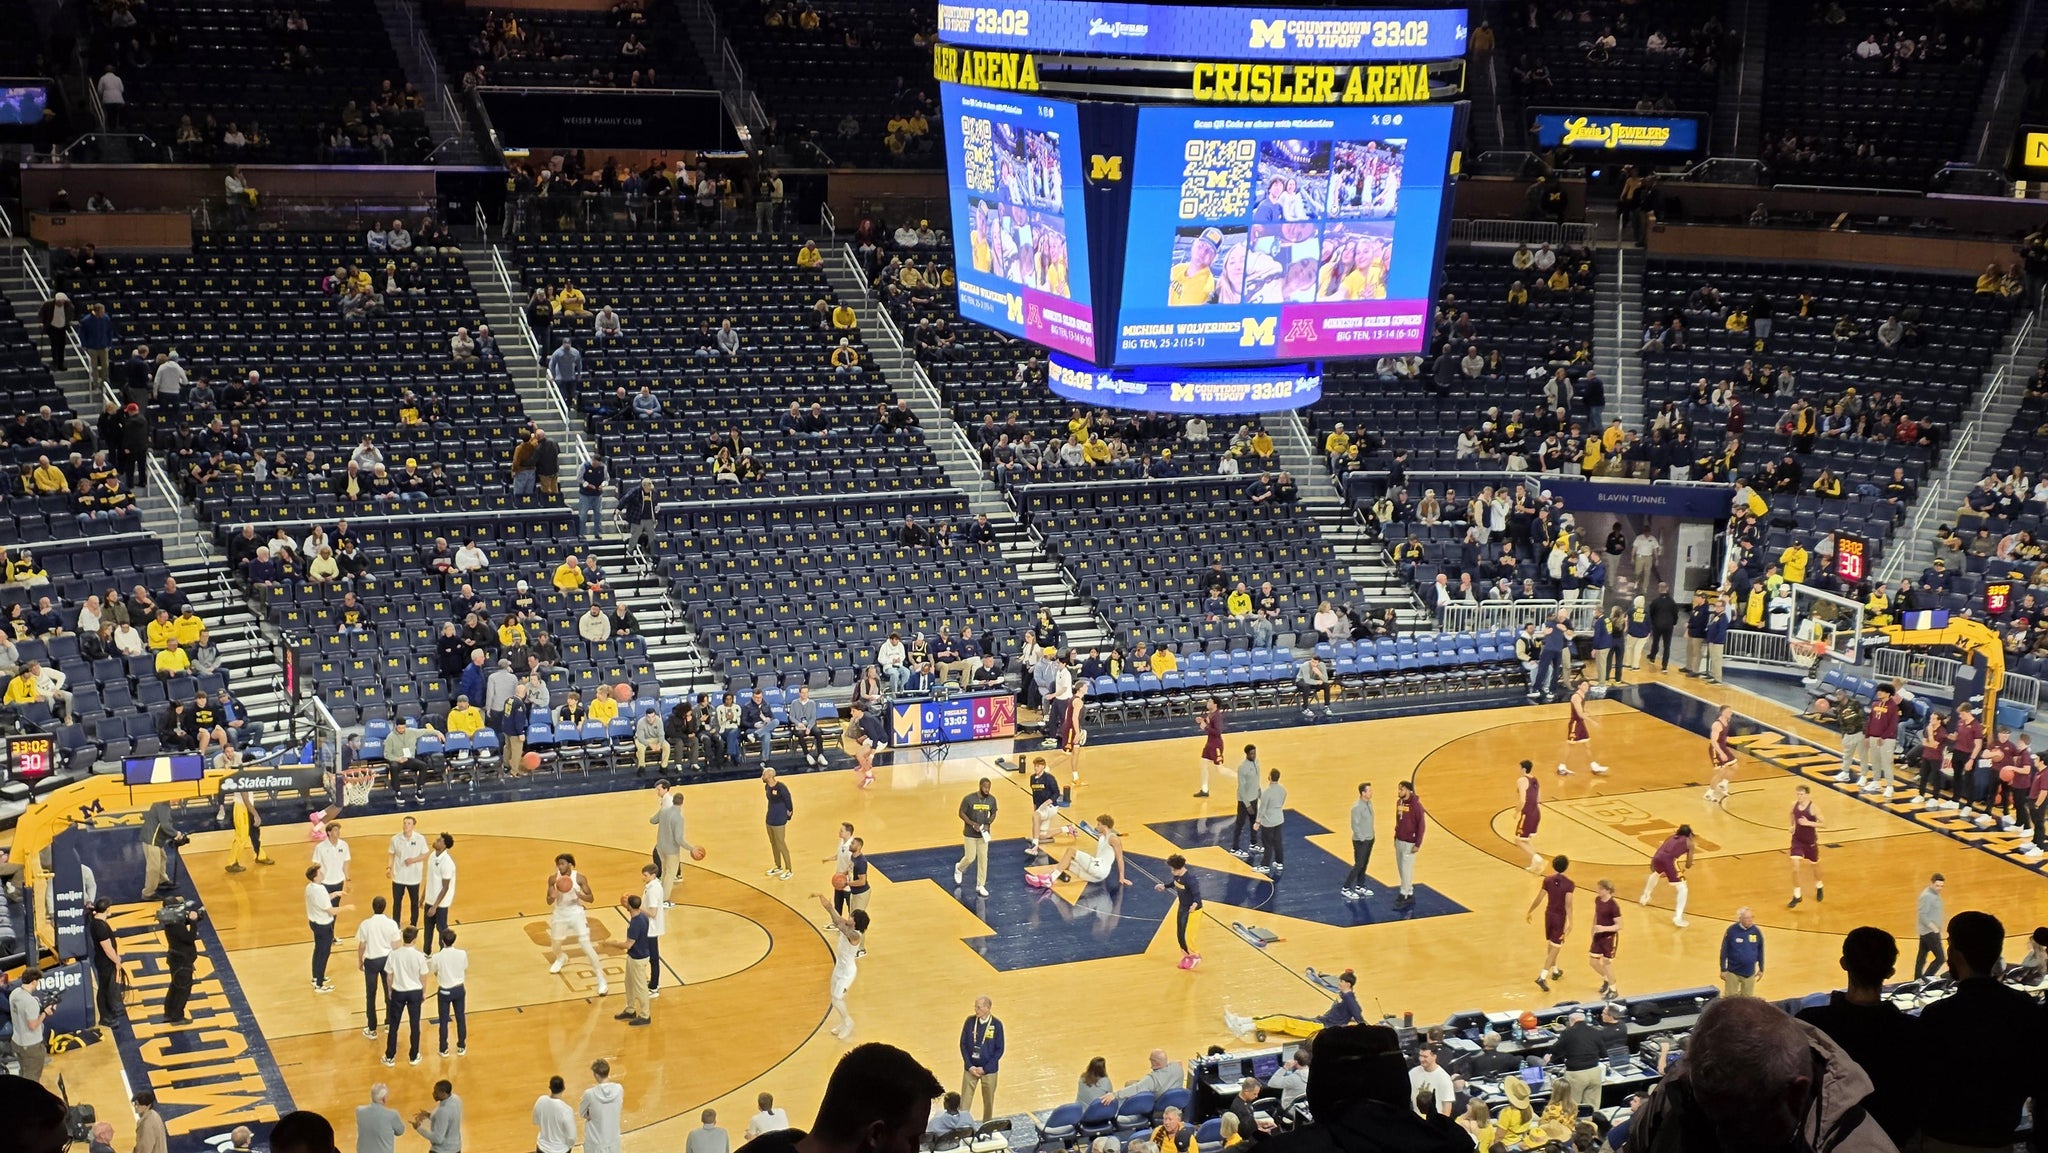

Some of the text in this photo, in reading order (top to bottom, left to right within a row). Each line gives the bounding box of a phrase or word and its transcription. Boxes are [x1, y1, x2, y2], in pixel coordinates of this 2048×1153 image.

[976, 8, 1029, 36] 33:02
[1287, 20, 1370, 35] COUNTDOWN
[1250, 19, 1286, 48] M
[1372, 21, 1428, 46] 33:02
[1296, 34, 1360, 48] TO TIPOFF
[961, 50, 1039, 90] ARENA
[1193, 63, 1430, 102] CRISLER ARENA
[563, 116, 642, 126] WEISER FAMILY CLUB
[1091, 155, 1122, 181] M
[1007, 292, 1024, 320] M
[1123, 322, 1241, 336] MICHIGAN WOLVERINES
[1239, 316, 1277, 347] M
[1336, 328, 1419, 342] BIG TEN, 13-14 (6-10)
[1122, 337, 1205, 350] BIG TEN, 25-2 (15-1)
[1062, 368, 1092, 391] 33:02
[1170, 382, 1195, 402] M
[1195, 383, 1249, 393] COUNTDOWN
[1250, 381, 1292, 400] 33:02
[1598, 493, 1666, 504] BLAVIN TUNNEL
[1841, 553, 1860, 576] 30
[1991, 595, 2004, 608] 30
[1956, 634, 1968, 646] M
[925, 711, 934, 723] 0
[977, 706, 985, 718] 0
[944, 716, 968, 726] 33:02
[12, 740, 48, 753] 33:02
[21, 755, 41, 771] 30
[78, 798, 104, 820] M
[57, 891, 82, 902] meijer
[57, 908, 84, 918] meijer
[58, 924, 84, 935] meijer
